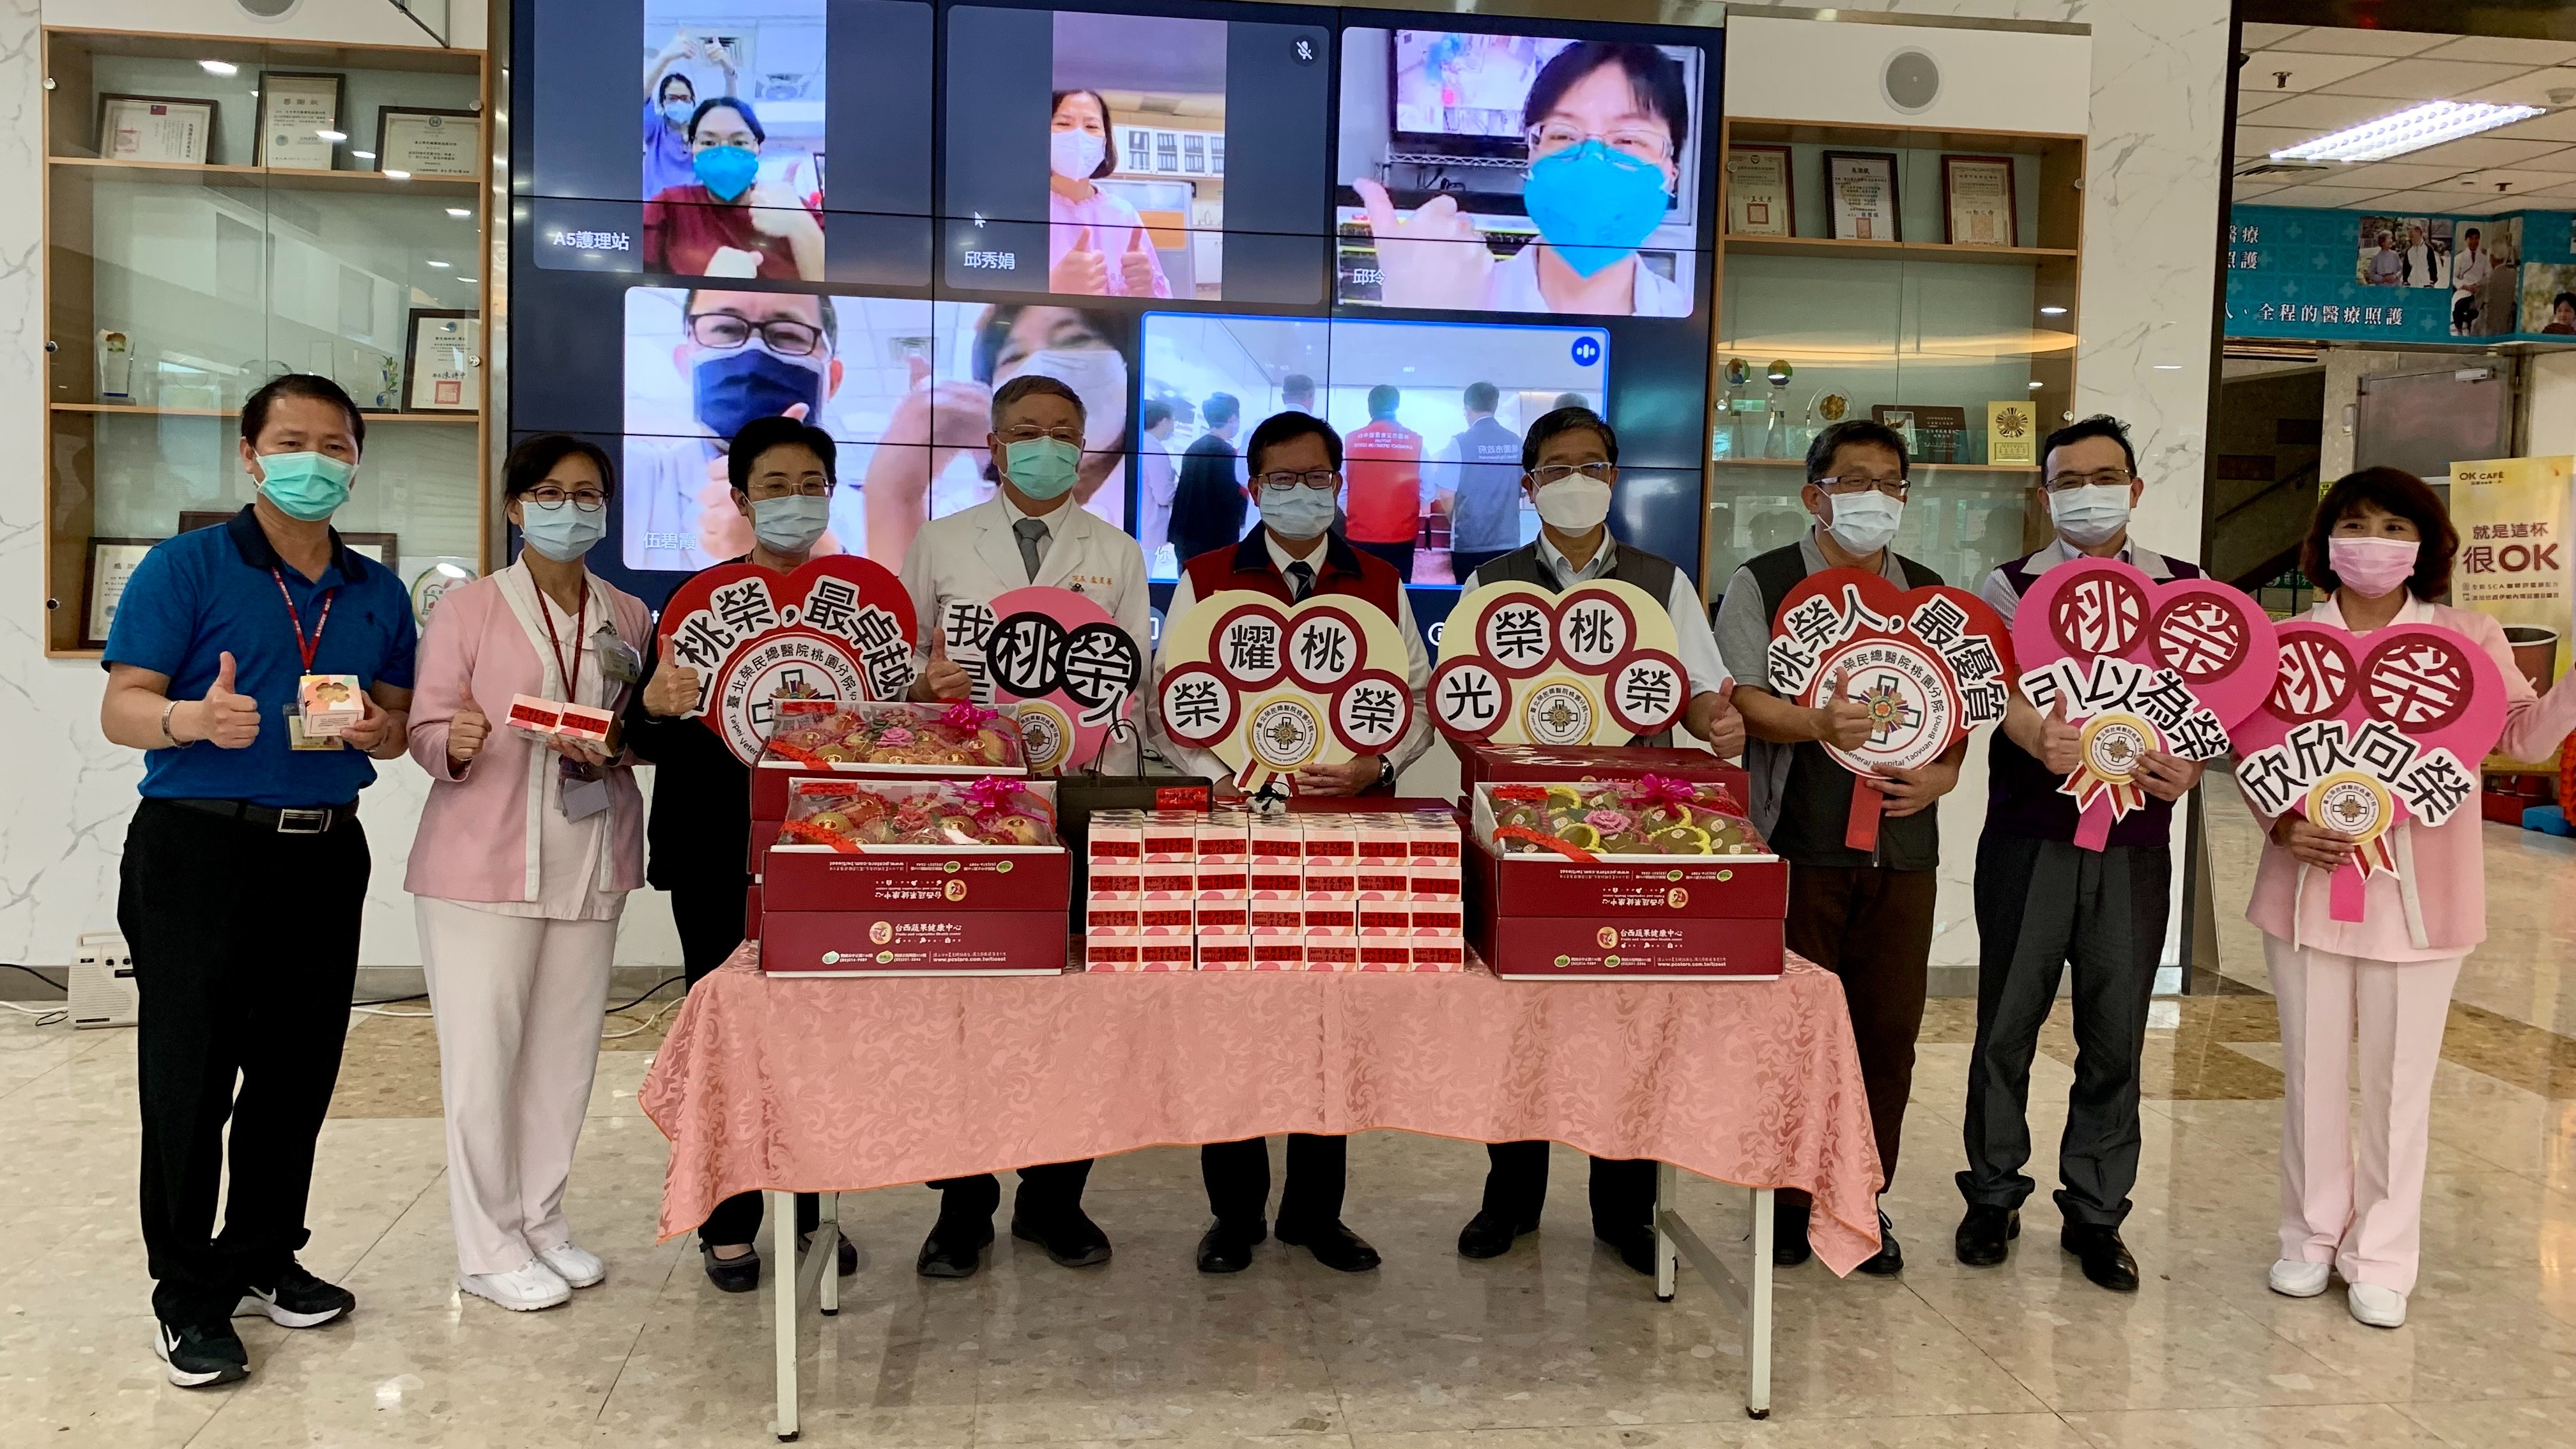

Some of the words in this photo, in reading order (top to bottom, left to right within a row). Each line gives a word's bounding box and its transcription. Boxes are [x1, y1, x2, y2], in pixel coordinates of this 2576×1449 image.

[553, 230, 630, 251] A5護理站
[963, 250, 1016, 270] 邱秀娟
[2459, 471, 2476, 480] OK
[2479, 471, 2504, 480] CAFÉ
[2472, 522, 2549, 540] 就是這杯
[726, 643, 856, 709] 臺北榮民總醫院桃園分院
[730, 714, 746, 737] Taipei
[1905, 740, 1933, 762] Taoyuan
[1928, 714, 1943, 740] Branch
[2241, 723, 2471, 823] 欣欣向榮
[894, 923, 962, 932] 台西蔬果健康中心
[1620, 928, 1683, 937] 台西蔬果健康中心
